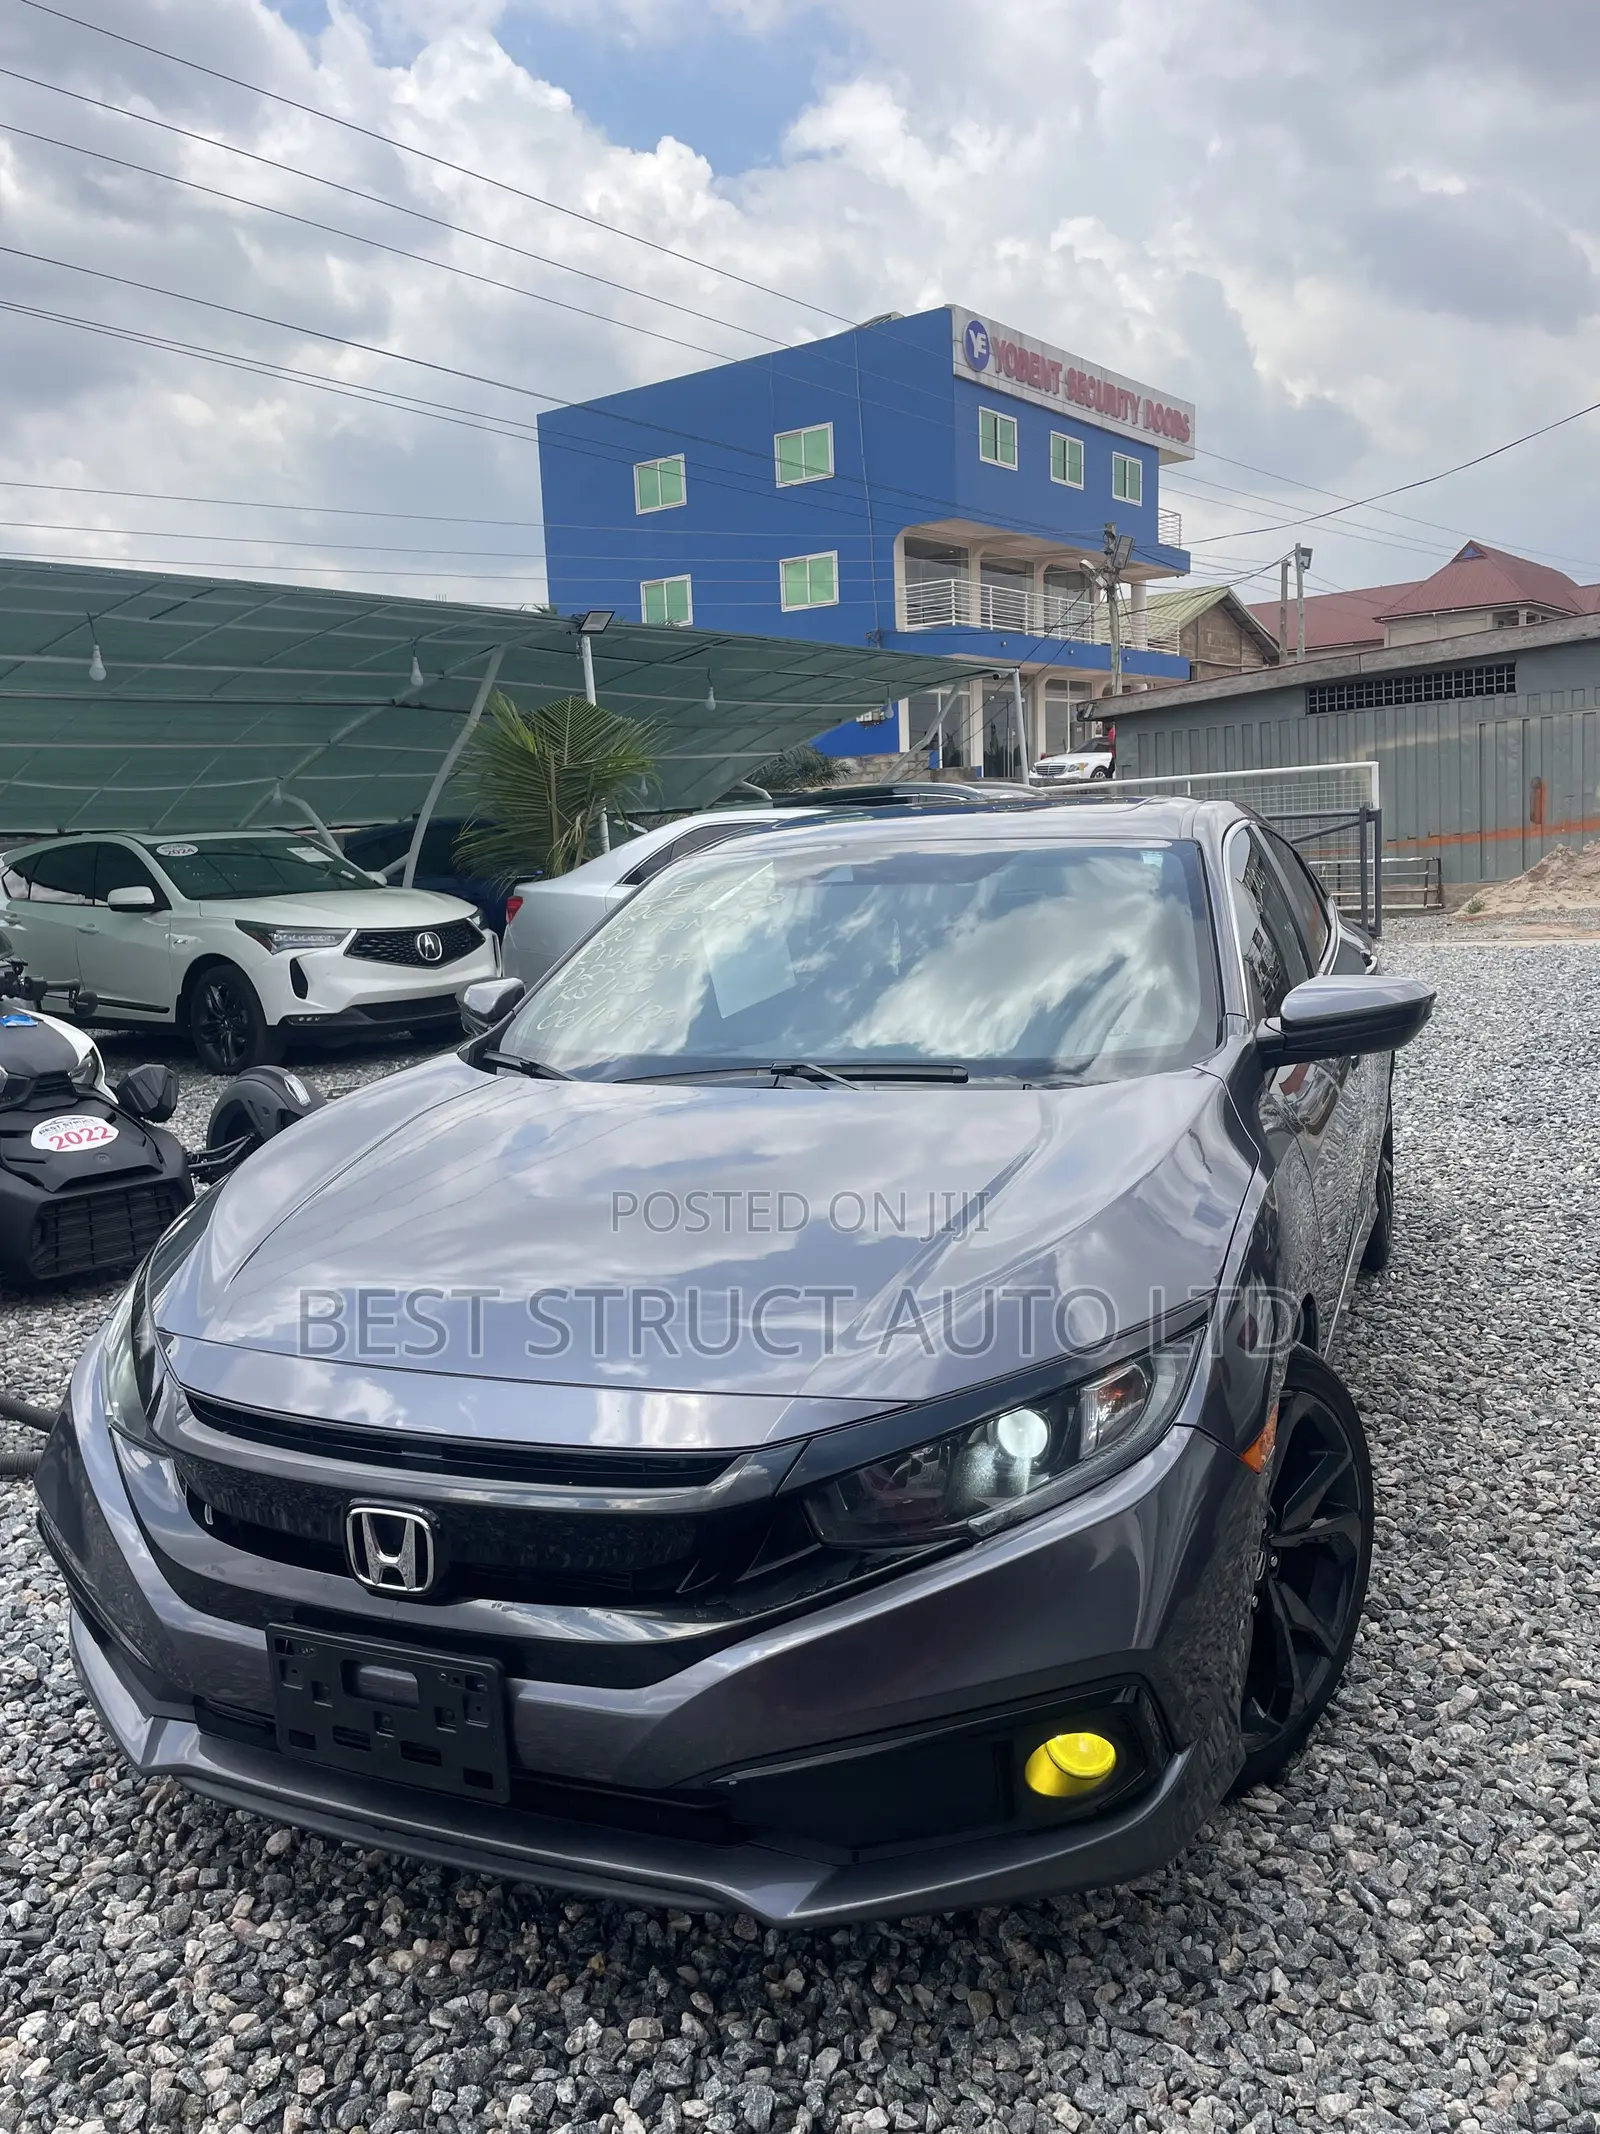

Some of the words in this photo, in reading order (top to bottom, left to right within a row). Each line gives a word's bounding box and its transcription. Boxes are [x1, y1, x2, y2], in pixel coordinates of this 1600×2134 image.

[992, 336, 1063, 395] YOBENT
[1065, 367, 1141, 425] SECURITY
[1143, 398, 1190, 443] DOORS
[48, 1126, 114, 1150] 2022
